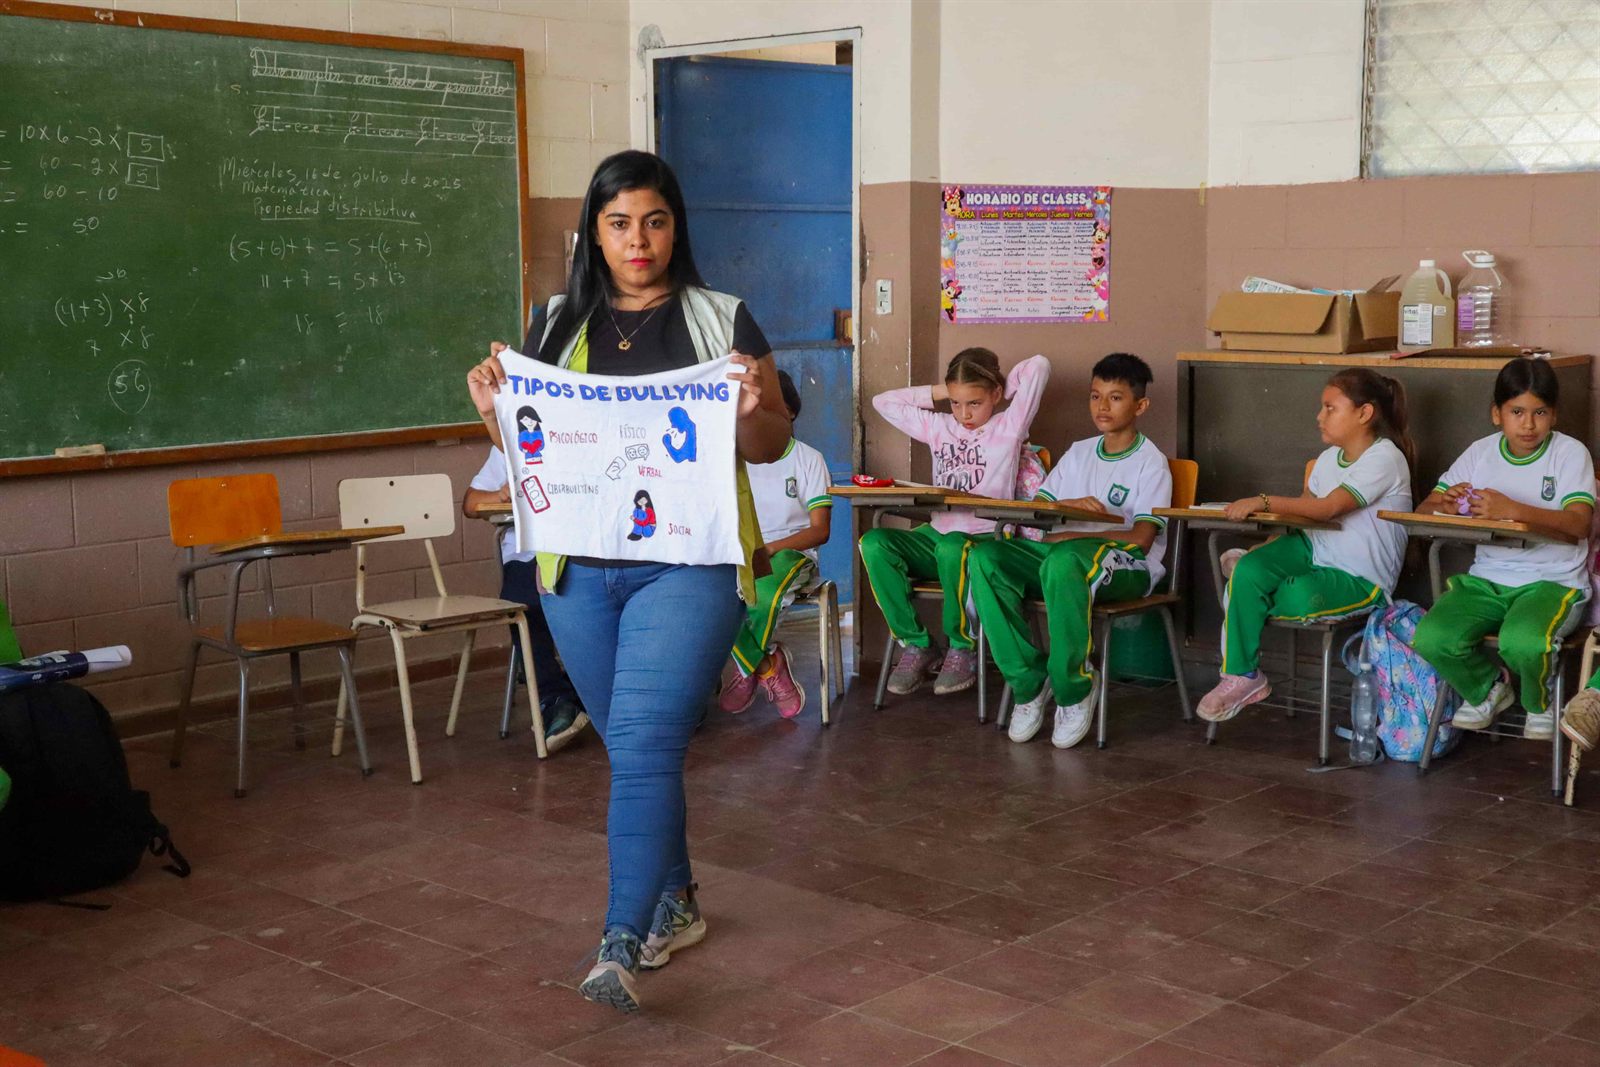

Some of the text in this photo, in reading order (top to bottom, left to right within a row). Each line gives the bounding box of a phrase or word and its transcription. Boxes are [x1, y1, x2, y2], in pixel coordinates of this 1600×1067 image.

[355, 75, 381, 85] con
[321, 163, 342, 180] de
[352, 166, 389, 187] julio
[401, 169, 417, 185] de
[328, 194, 417, 218] distributiva
[966, 193, 1087, 205] HORARIO DE CLASES
[508, 374, 730, 402] TIPOS DE BULLYING
[549, 430, 598, 444] PSICOLÓGICO
[638, 465, 662, 478] VERBAL
[668, 522, 692, 536] SOCIAL
